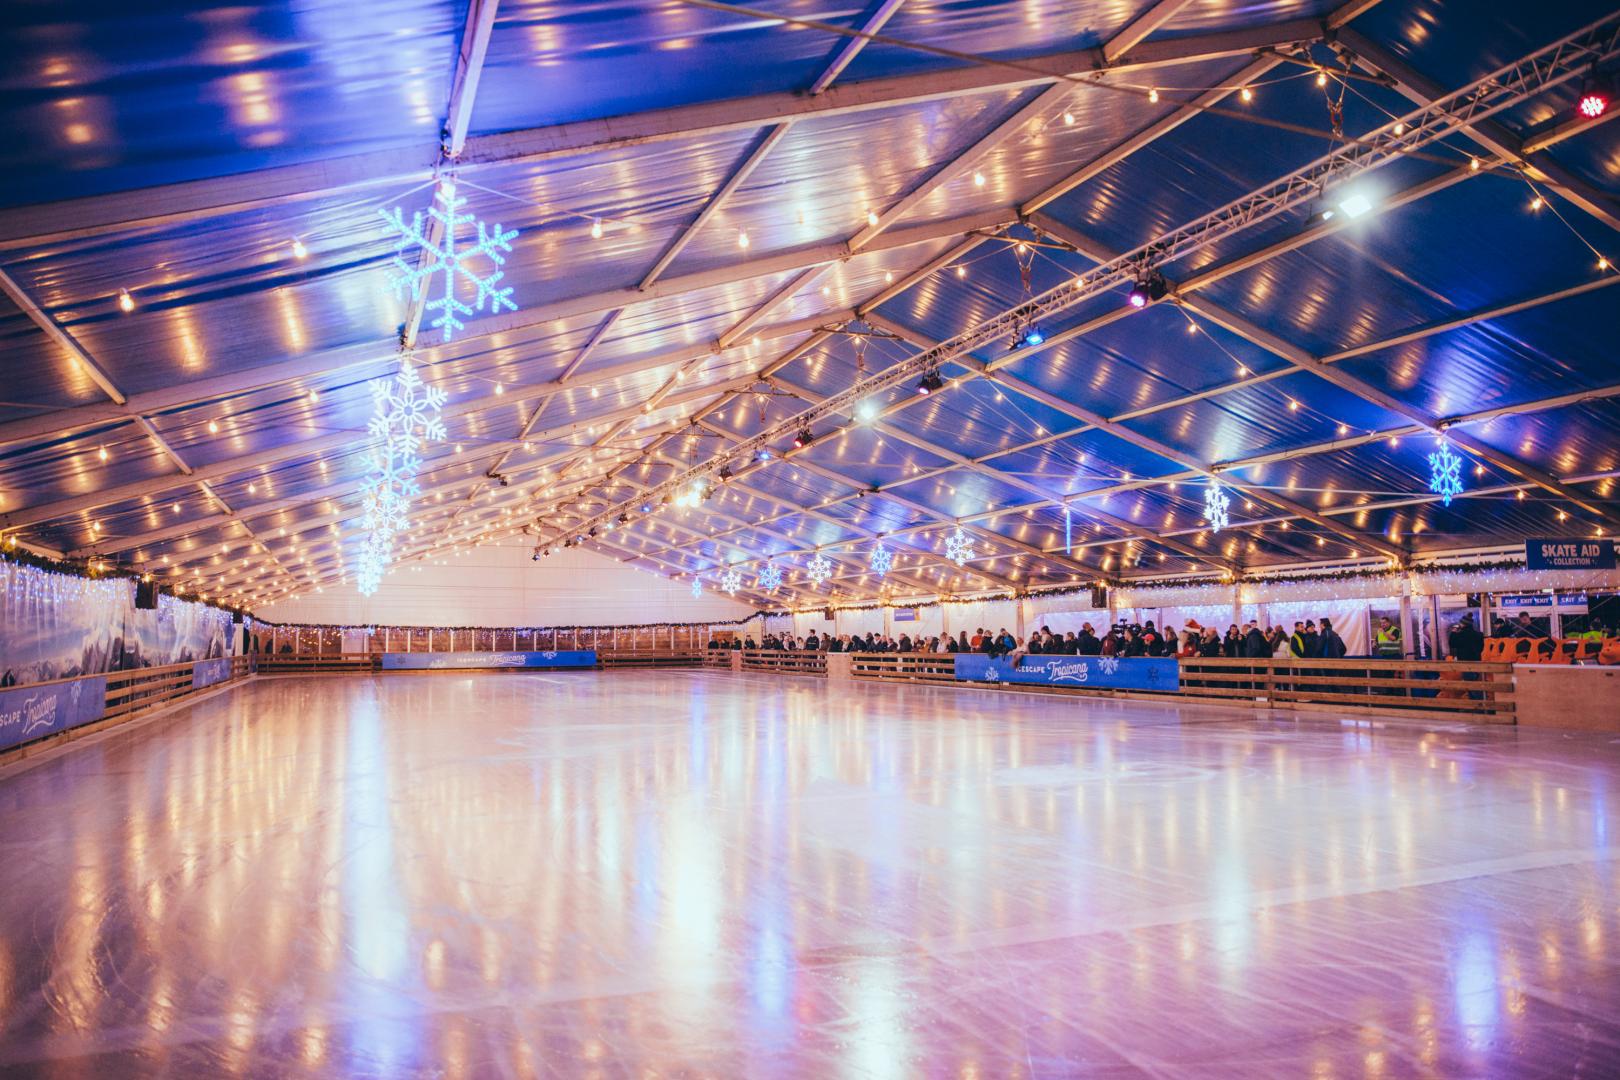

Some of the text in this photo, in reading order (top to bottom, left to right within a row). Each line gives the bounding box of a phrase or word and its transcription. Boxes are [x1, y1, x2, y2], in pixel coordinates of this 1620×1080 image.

[1541, 544, 1600, 557] SKATE AID
[1553, 558, 1591, 566] COLLECTION
[1047, 659, 1088, 682] Tropicana
